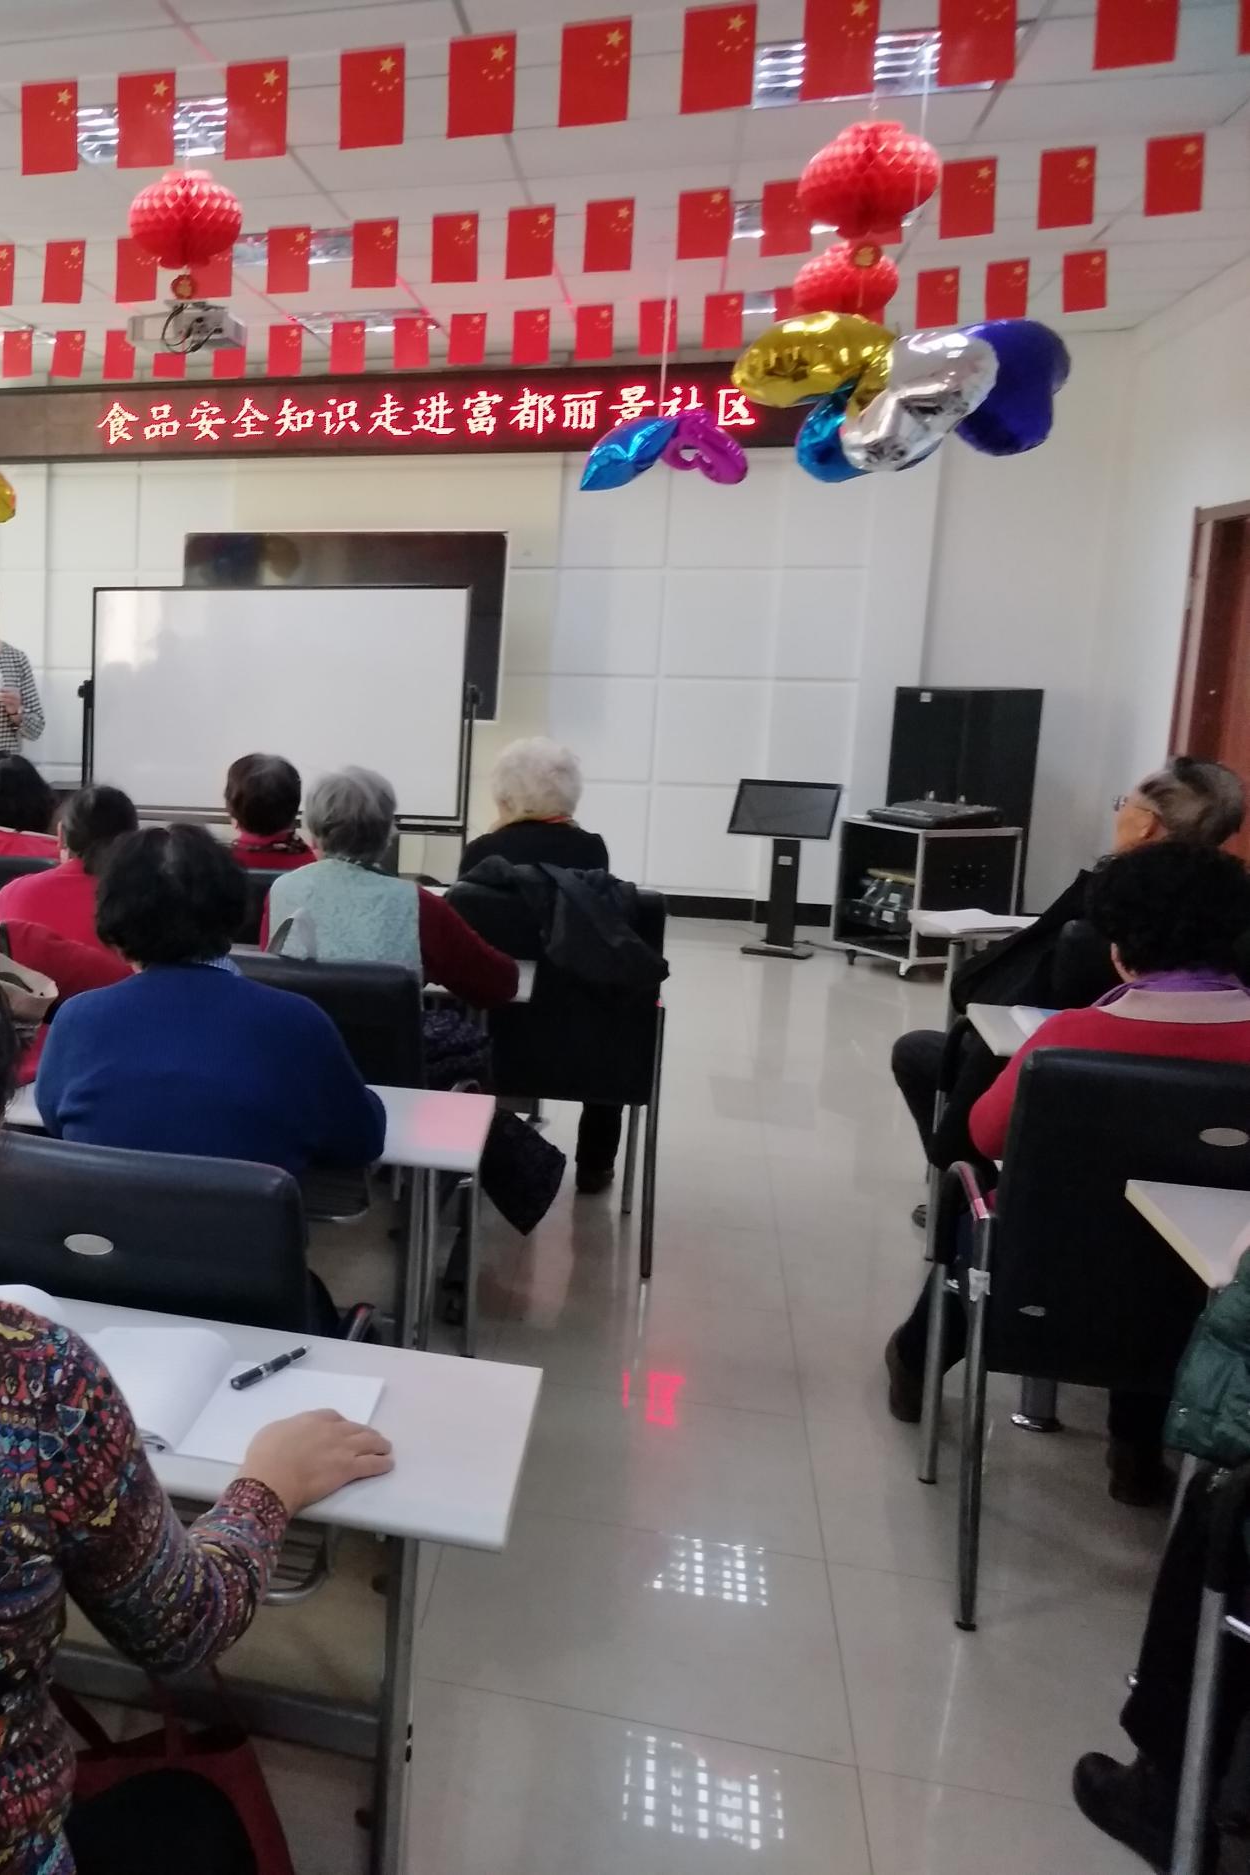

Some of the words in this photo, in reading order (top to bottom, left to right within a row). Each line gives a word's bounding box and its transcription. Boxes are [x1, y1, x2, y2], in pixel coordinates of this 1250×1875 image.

[97, 385, 756, 445] 食品安全知识走进富都丽景社区
